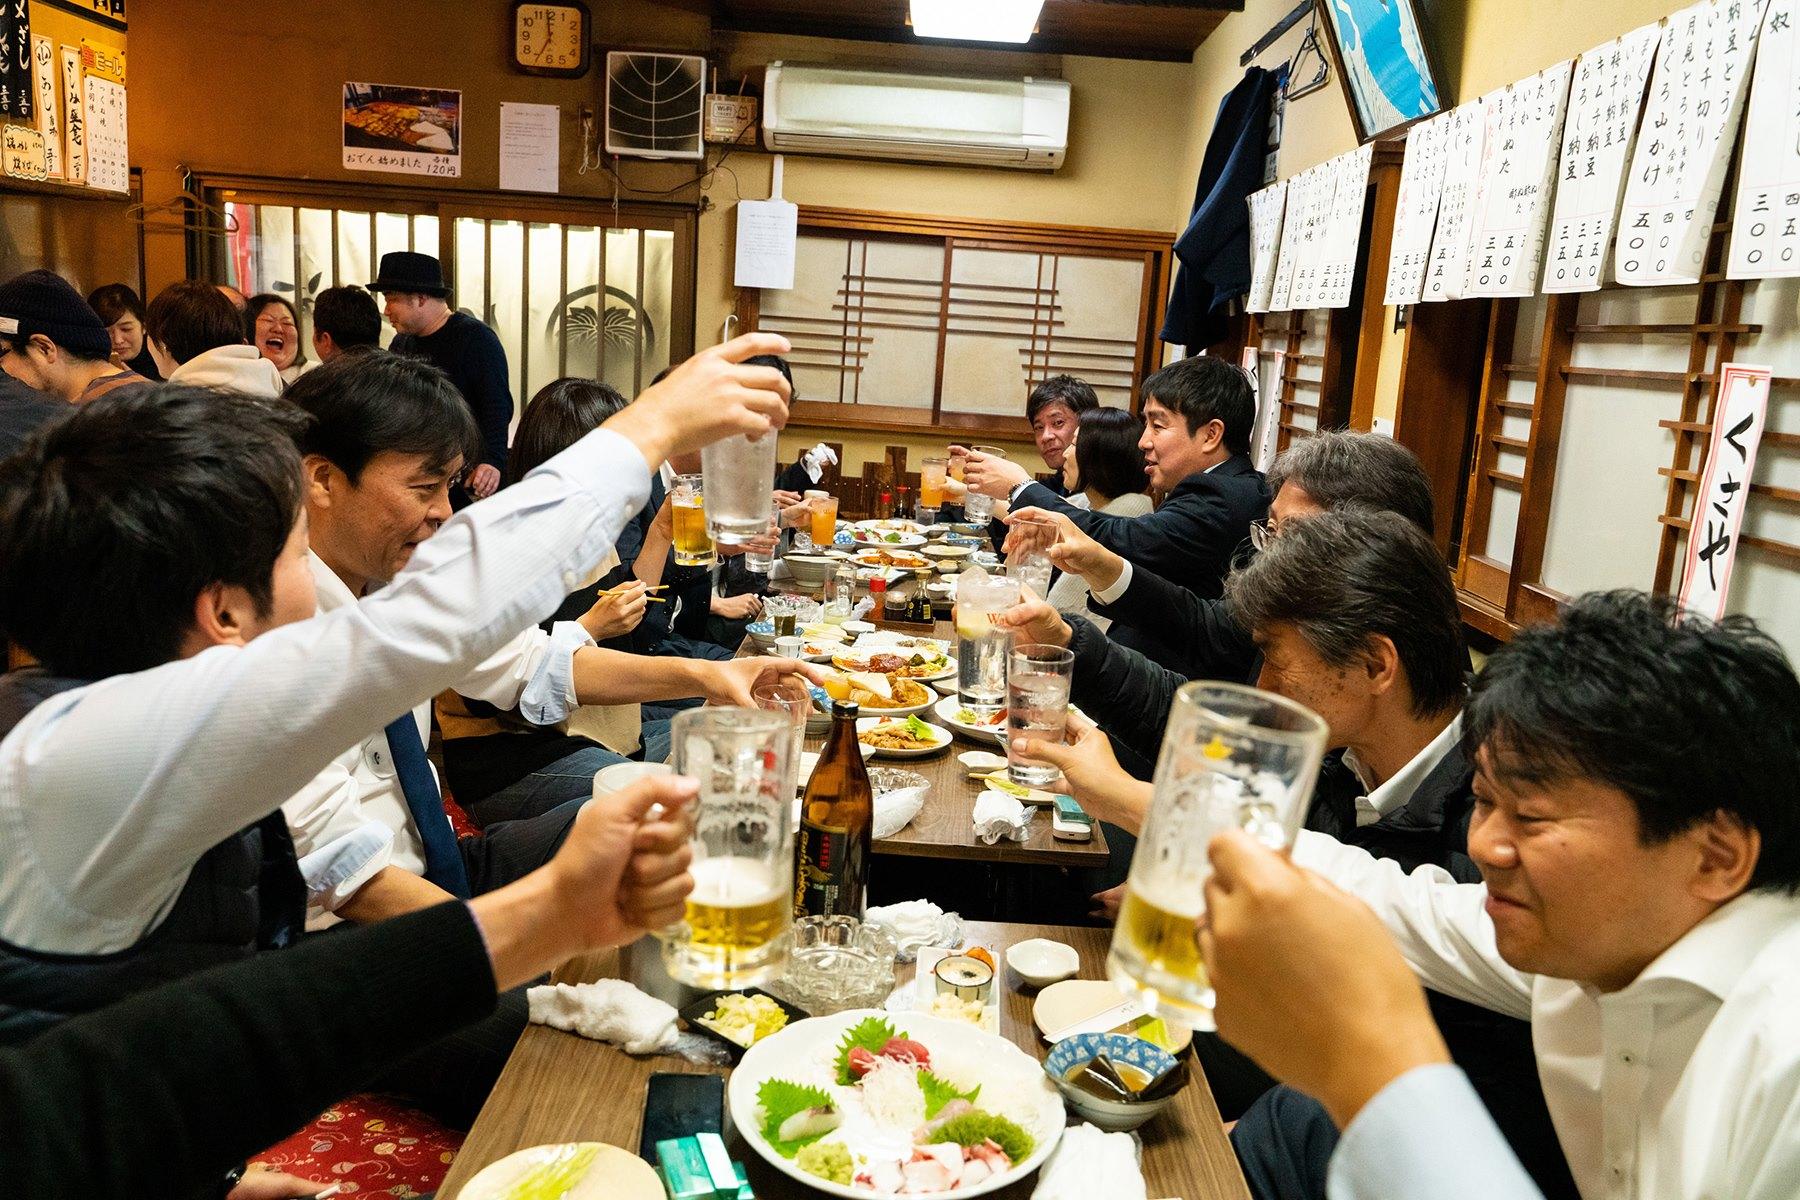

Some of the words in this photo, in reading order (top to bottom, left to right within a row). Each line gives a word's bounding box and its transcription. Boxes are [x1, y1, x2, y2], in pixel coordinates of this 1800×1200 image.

[523, 17, 534, 27] 10
[534, 11, 543, 20] 11
[561, 13, 565, 21] 1
[569, 21, 577, 30] 2
[1770, 12, 1790, 34] 奴
[522, 31, 530, 40] 9
[523, 45, 531, 54] 8
[569, 49, 576, 57] 4
[570, 34, 577, 44] 3
[534, 53, 540, 63] 7
[546, 54, 553, 64] 6
[559, 55, 566, 64] 5
[1676, 15, 1697, 142] 月見とろろ
[1696, 12, 1720, 149] いも千切り
[1535, 84, 1544, 121] たこ
[1585, 55, 1605, 177] キムチ納豆
[1643, 28, 1675, 186] まぐろ山かけ
[1564, 64, 1590, 180] おろし納豆
[347, 152, 422, 168] おでん始めました
[426, 164, 457, 176] 120円
[1499, 139, 1514, 174] ぬた
[1623, 211, 1650, 272] 五〇〇
[1656, 211, 1674, 272] 四〇〇
[1747, 193, 1769, 264] 三〇〇
[1781, 192, 1800, 262] 四五〇
[1479, 236, 1496, 285] 三五〇
[1499, 235, 1514, 284] 五〇〇
[1557, 225, 1569, 280] 三五〇
[1573, 222, 1586, 278] 三五〇
[1588, 220, 1602, 277] 三五〇
[1697, 411, 1754, 592] くさや
